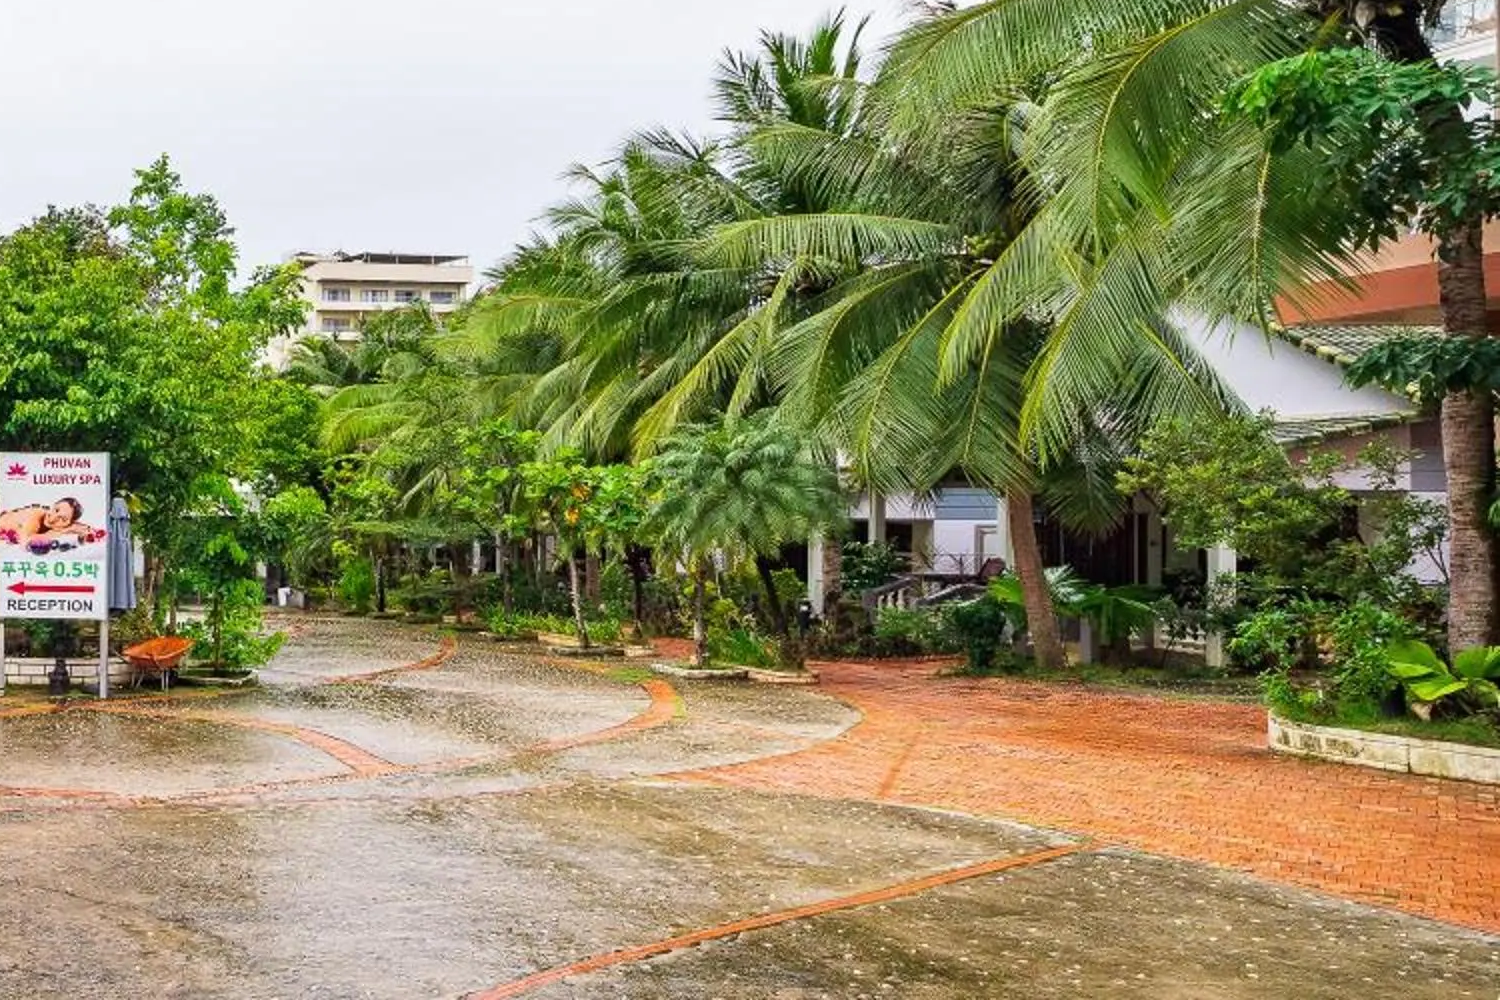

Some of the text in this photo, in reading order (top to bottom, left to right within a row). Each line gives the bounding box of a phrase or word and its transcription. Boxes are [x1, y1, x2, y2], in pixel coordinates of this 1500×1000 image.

[43, 458, 91, 469] PHUVAN
[33, 474, 101, 485] LUXURY SPA
[1, 561, 49, 578] 푸꾸옥
[7, 599, 93, 612] RECEPTION
